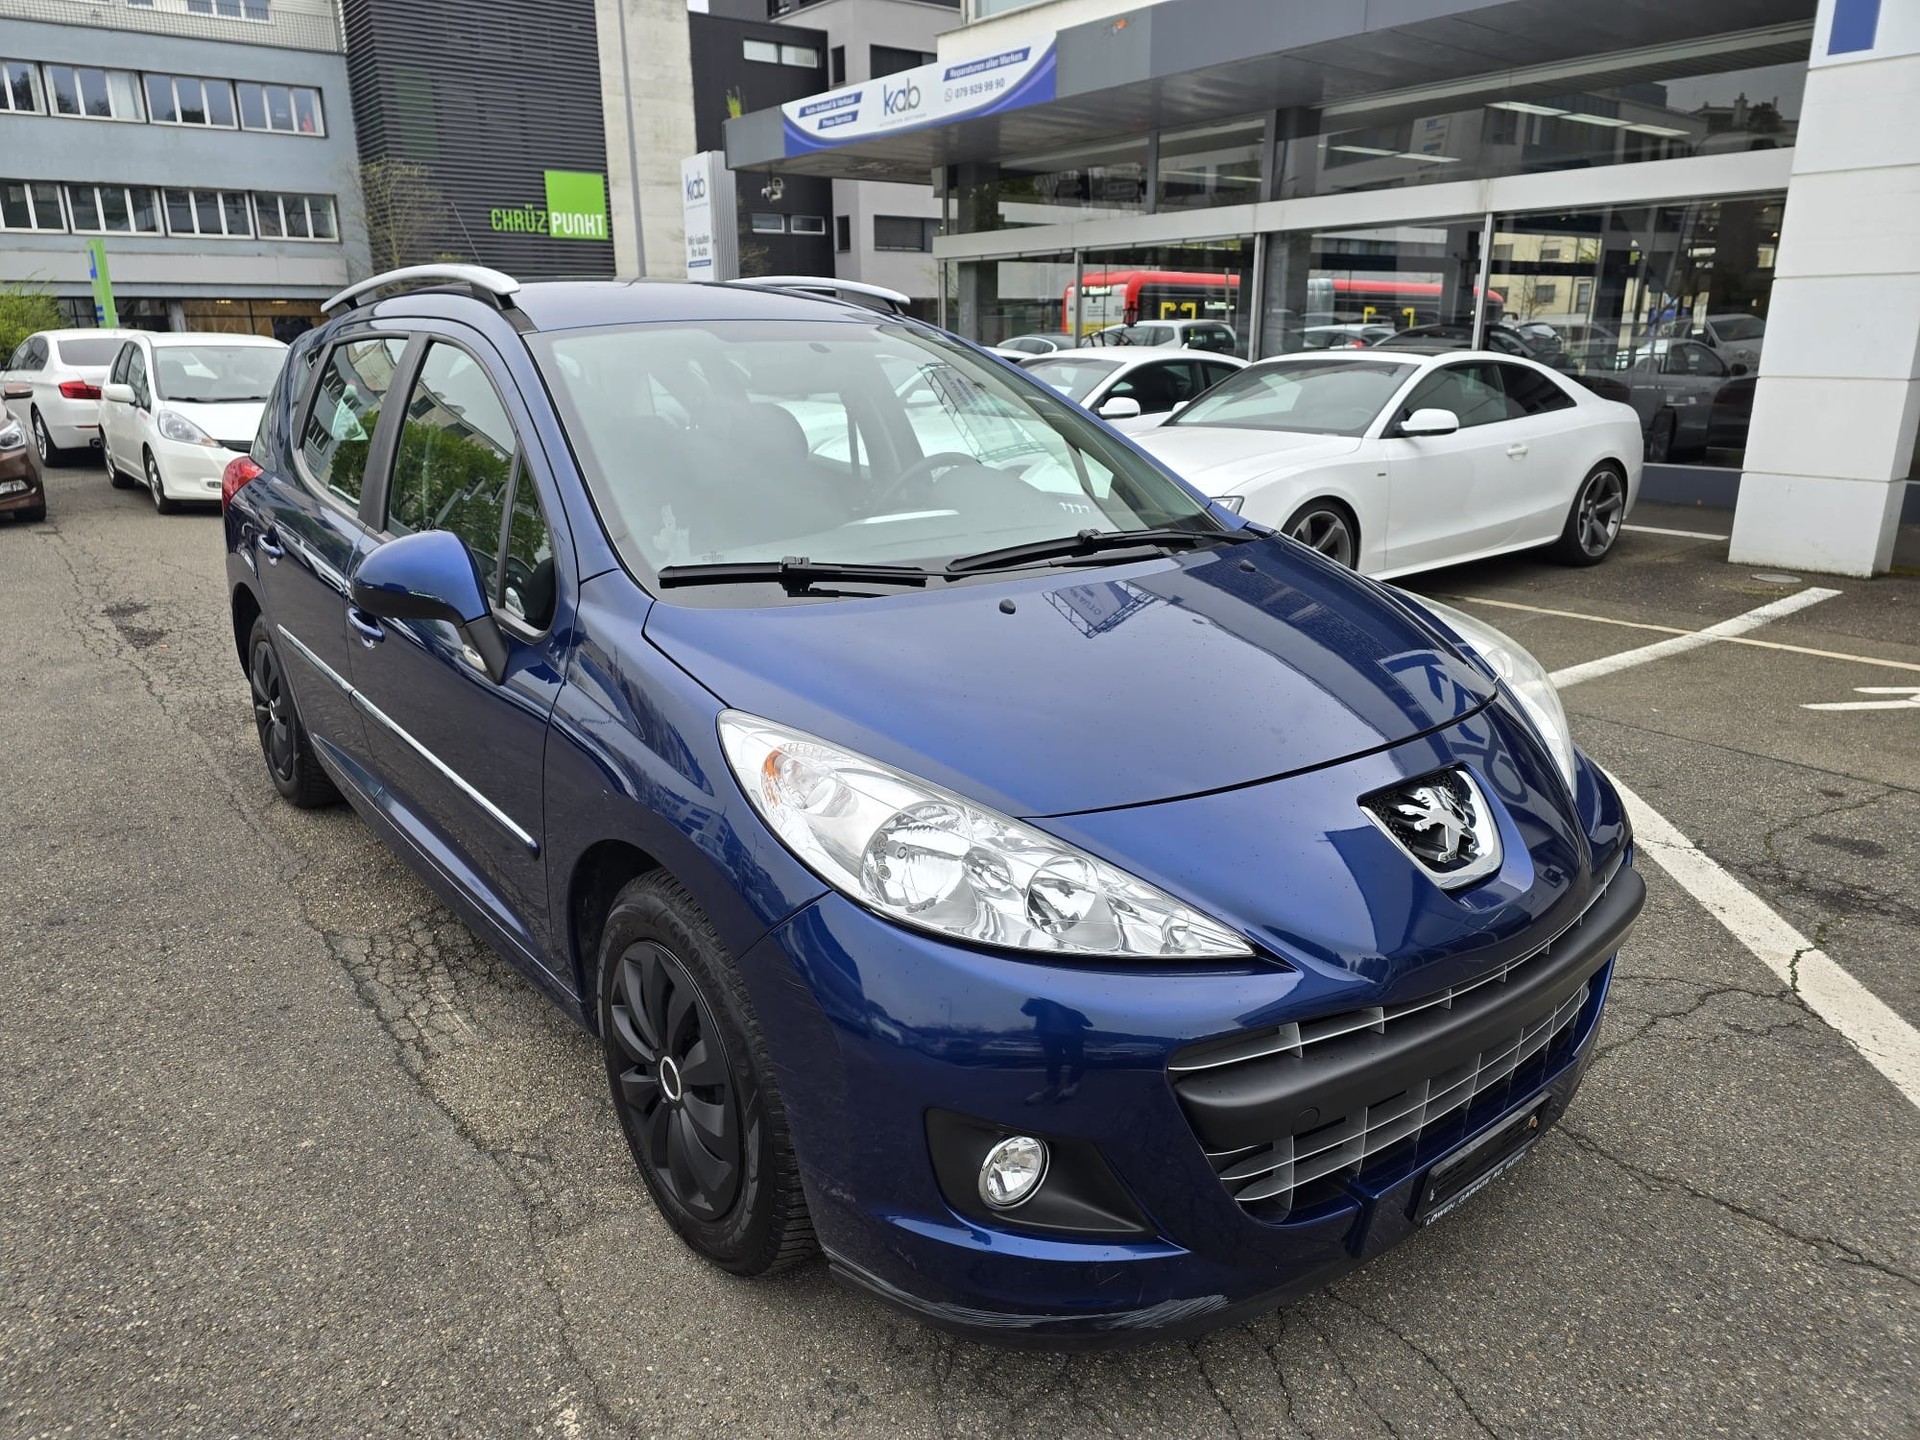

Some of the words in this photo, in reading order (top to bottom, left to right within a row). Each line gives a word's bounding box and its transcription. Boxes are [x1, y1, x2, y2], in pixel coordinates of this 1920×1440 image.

[883, 77, 921, 116] kab
[954, 86, 968, 99] 079
[984, 80, 993, 92] 99
[995, 77, 1006, 88] 90
[685, 171, 706, 202] kab
[491, 204, 548, 233] CHRÜZ
[551, 211, 604, 236] PUNKT
